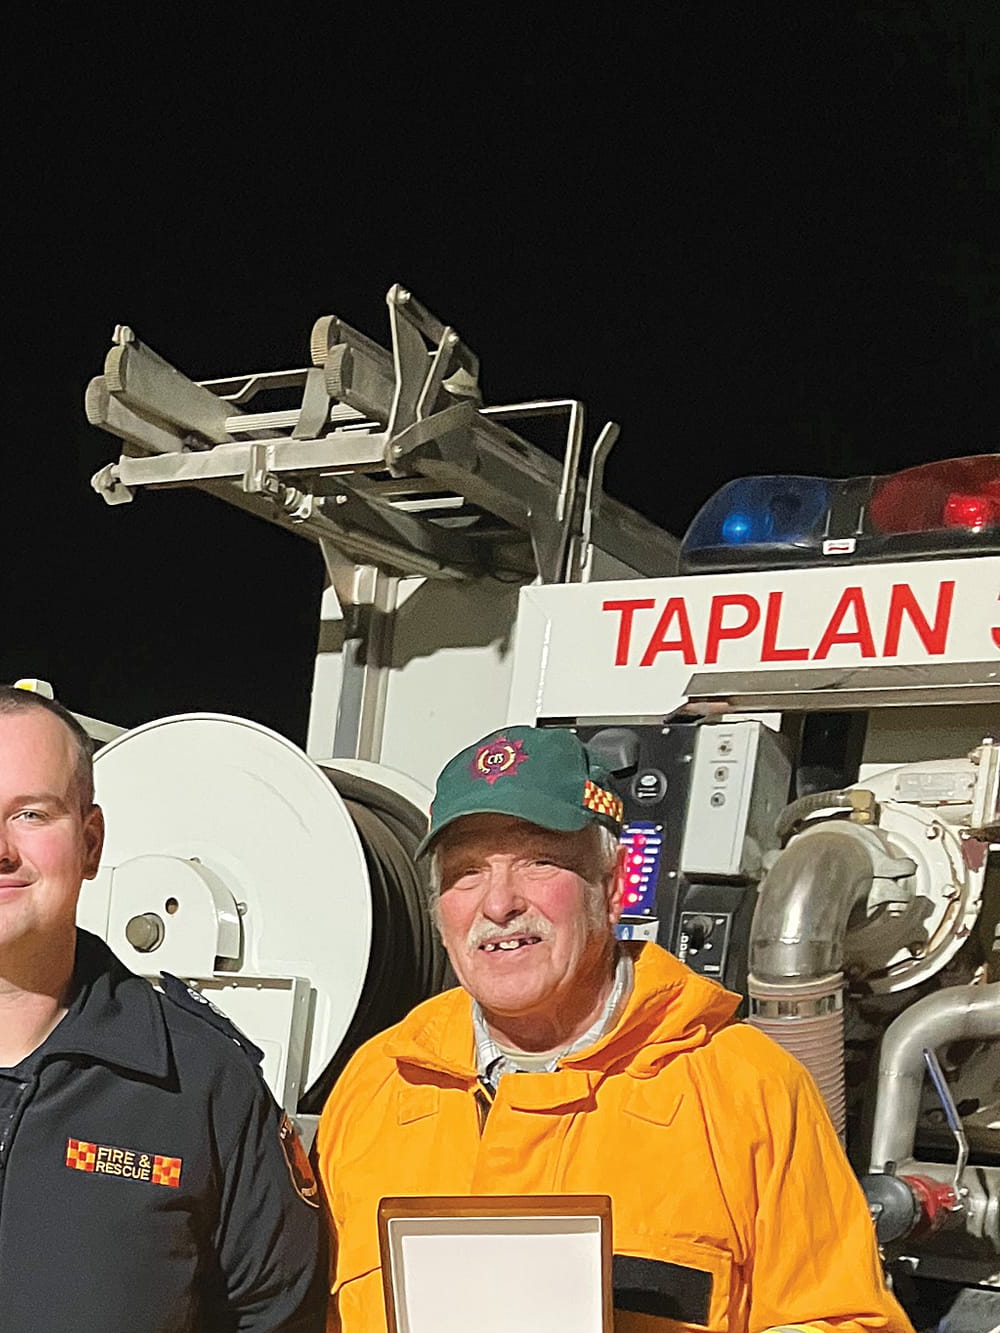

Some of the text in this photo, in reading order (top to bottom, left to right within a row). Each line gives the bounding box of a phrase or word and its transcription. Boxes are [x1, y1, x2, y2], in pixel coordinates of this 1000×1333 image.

[602, 581, 955, 666] TAPLAN
[98, 1147, 151, 1169] FIRE &
[95, 1161, 151, 1181] RESCUE
